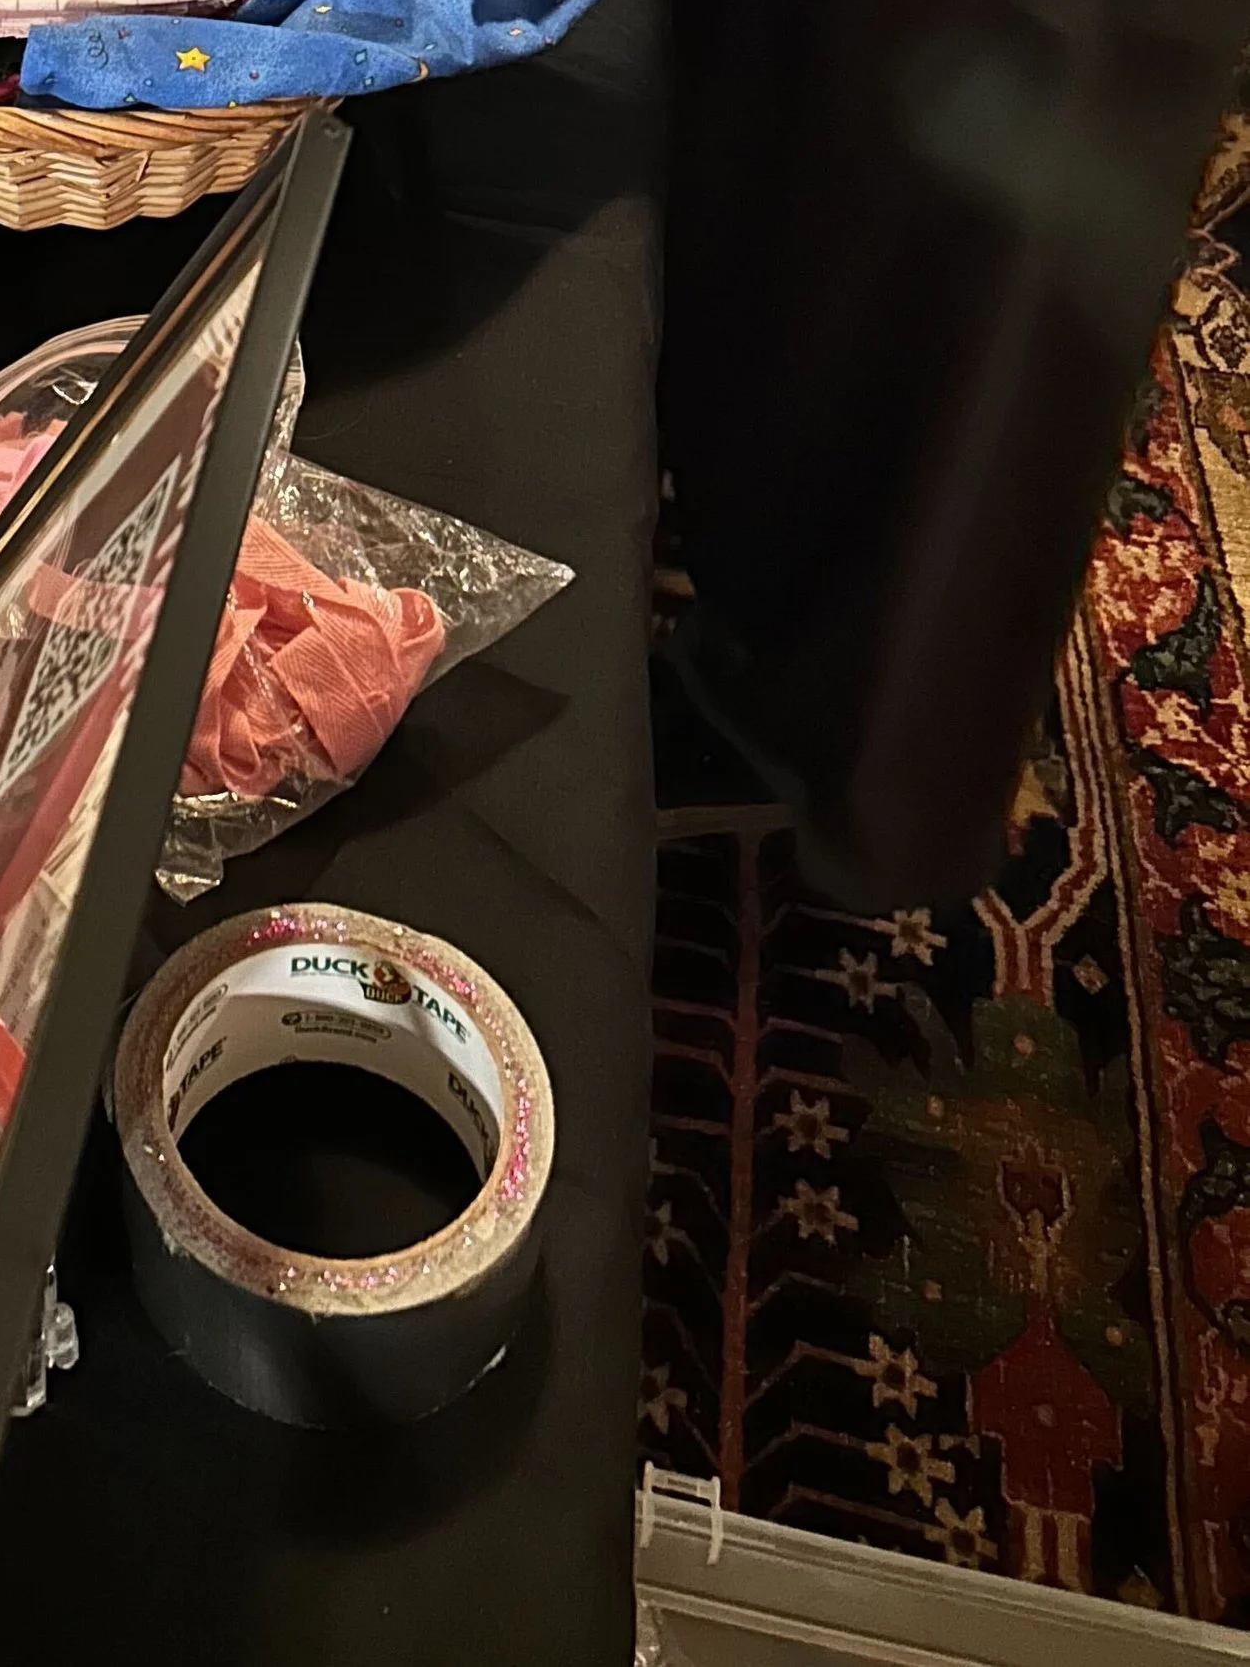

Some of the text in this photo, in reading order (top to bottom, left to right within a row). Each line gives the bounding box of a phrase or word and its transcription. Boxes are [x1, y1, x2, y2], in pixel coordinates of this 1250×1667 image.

[289, 956, 469, 1043] DUCK TAPE
[366, 987, 402, 1004] DUCK
[179, 1043, 225, 1094] TAPE
